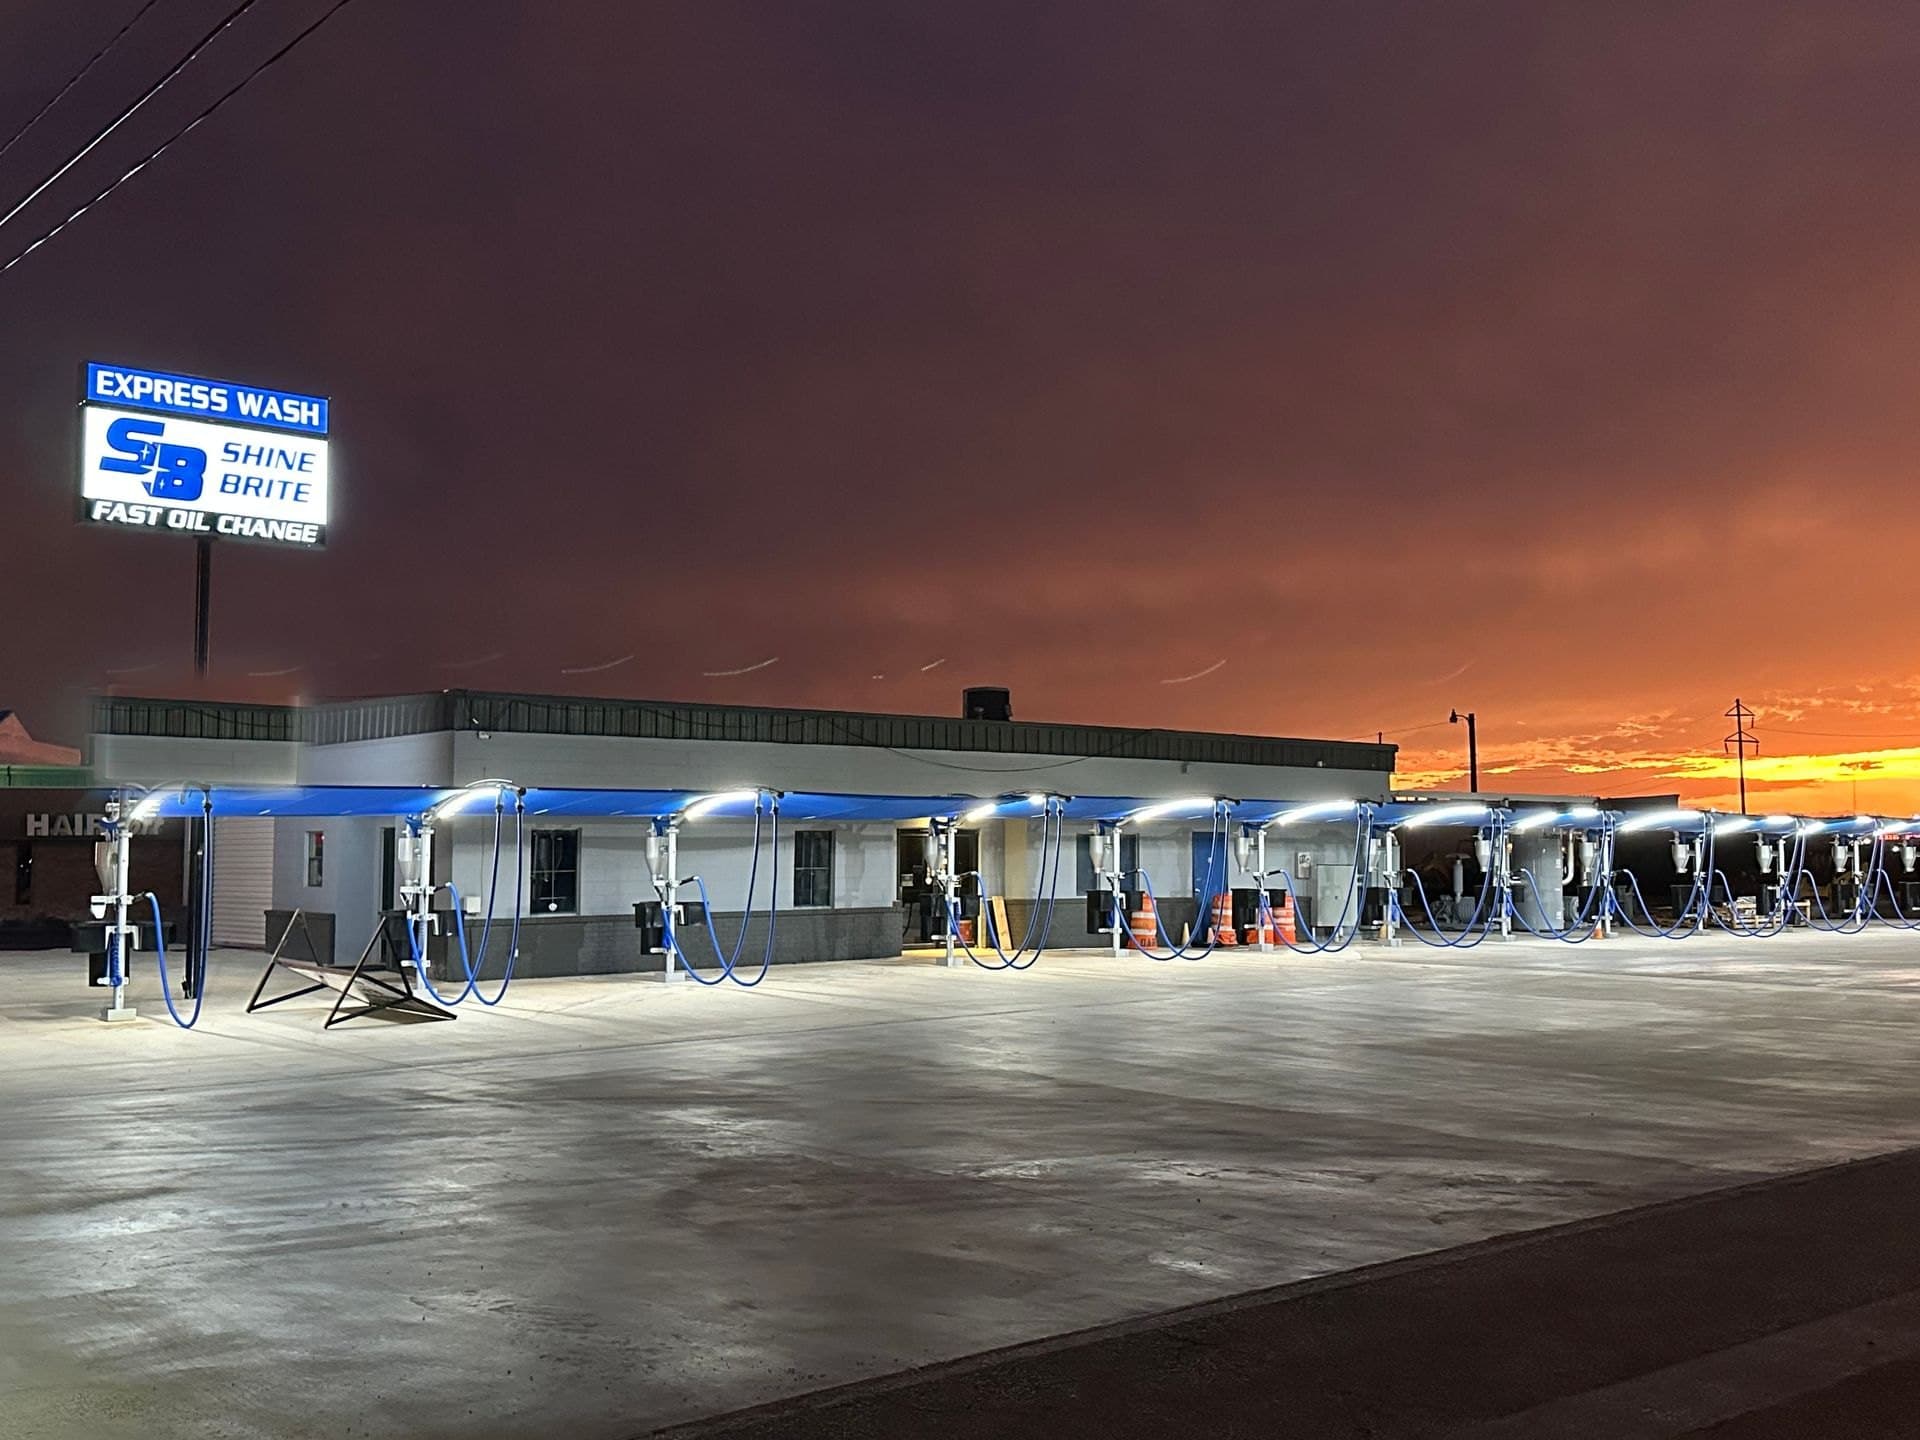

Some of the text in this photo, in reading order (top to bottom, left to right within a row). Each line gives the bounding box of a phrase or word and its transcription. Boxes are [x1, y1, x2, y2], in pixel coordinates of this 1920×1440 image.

[96, 370, 320, 426] EXPRESS WASH
[221, 442, 317, 473] SHINE
[219, 473, 313, 503] BRITE
[91, 500, 319, 543] FAST OIL CHANGE
